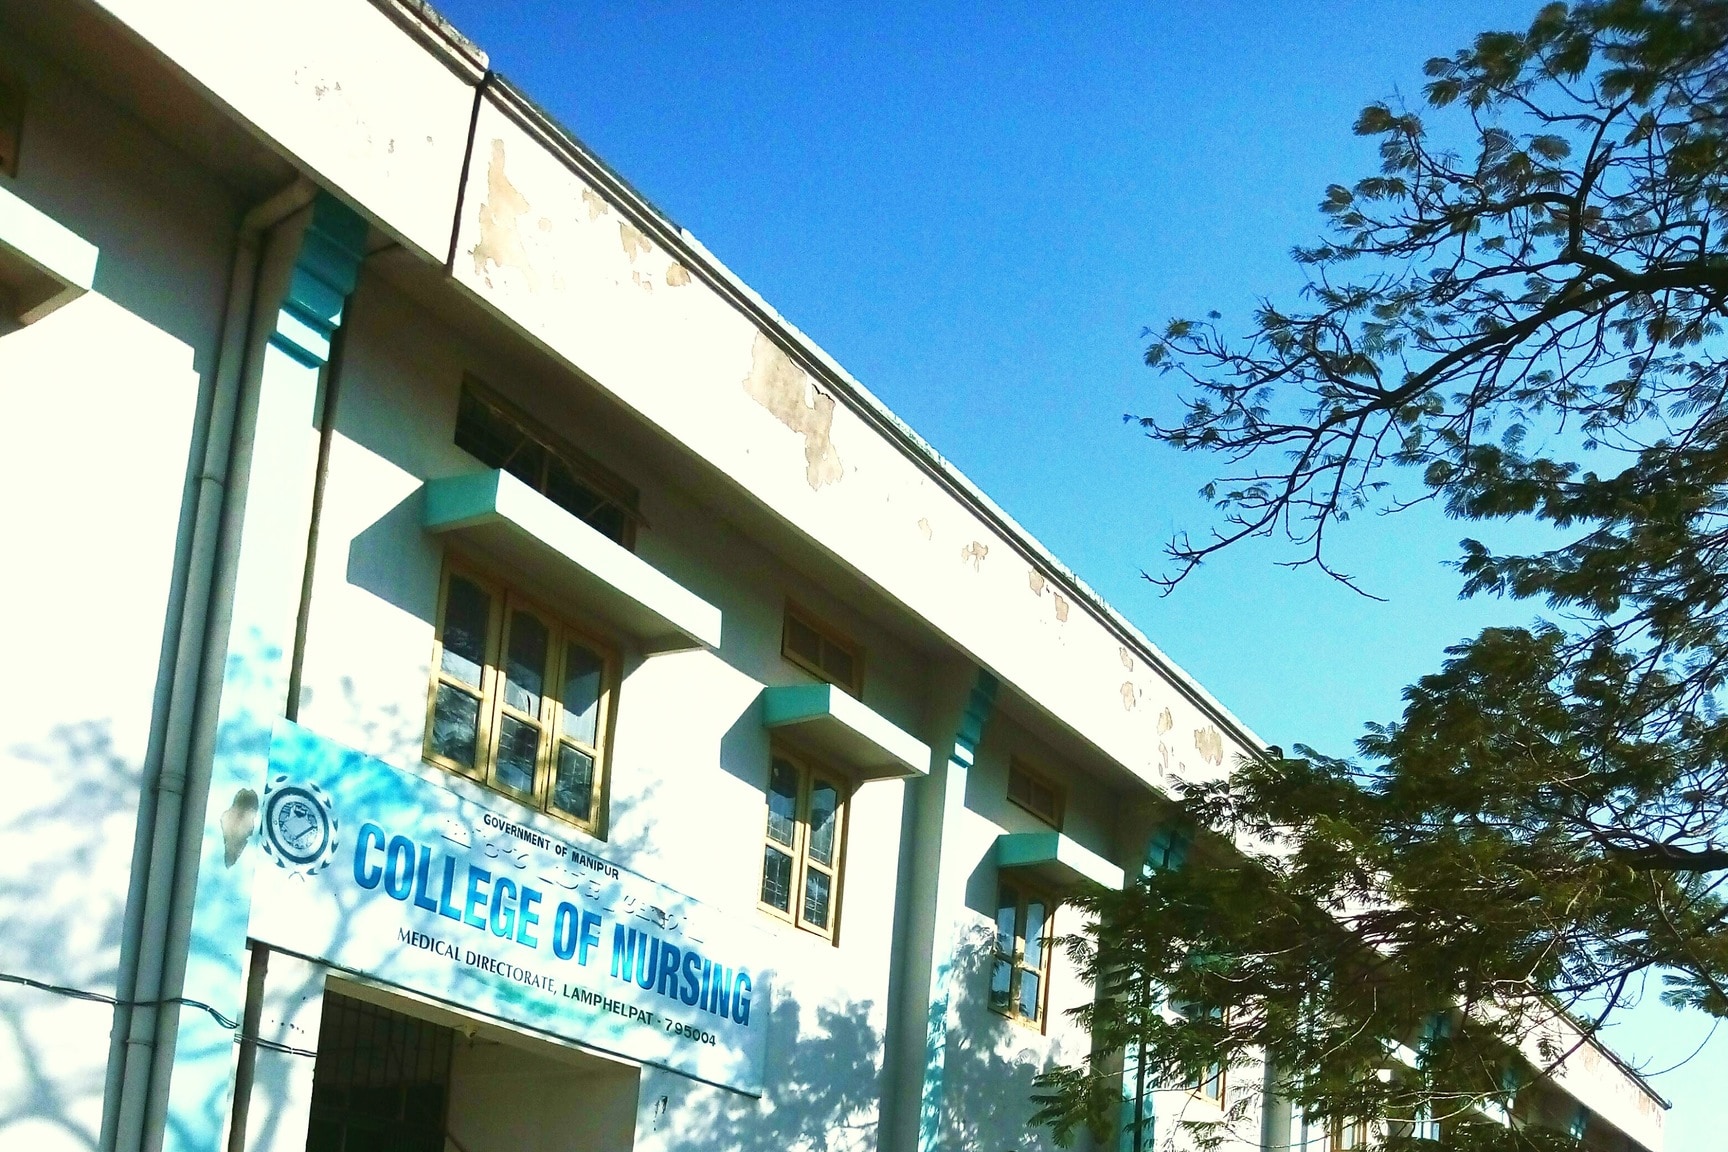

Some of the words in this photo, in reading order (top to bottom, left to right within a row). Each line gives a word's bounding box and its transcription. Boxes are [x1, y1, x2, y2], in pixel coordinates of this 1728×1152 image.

[483, 813, 551, 850] GOVERNMENT
[555, 844, 568, 858] OF
[572, 851, 620, 881] MANIPUR
[353, 822, 543, 949] COLLEGE
[552, 901, 602, 966] OF
[610, 922, 752, 1026] NURSING
[397, 927, 462, 962] MEDICAL
[465, 950, 557, 995] DIRECTORATE,
[563, 984, 654, 1026] LAMPHELPAT
[664, 1018, 716, 1047] 795004
